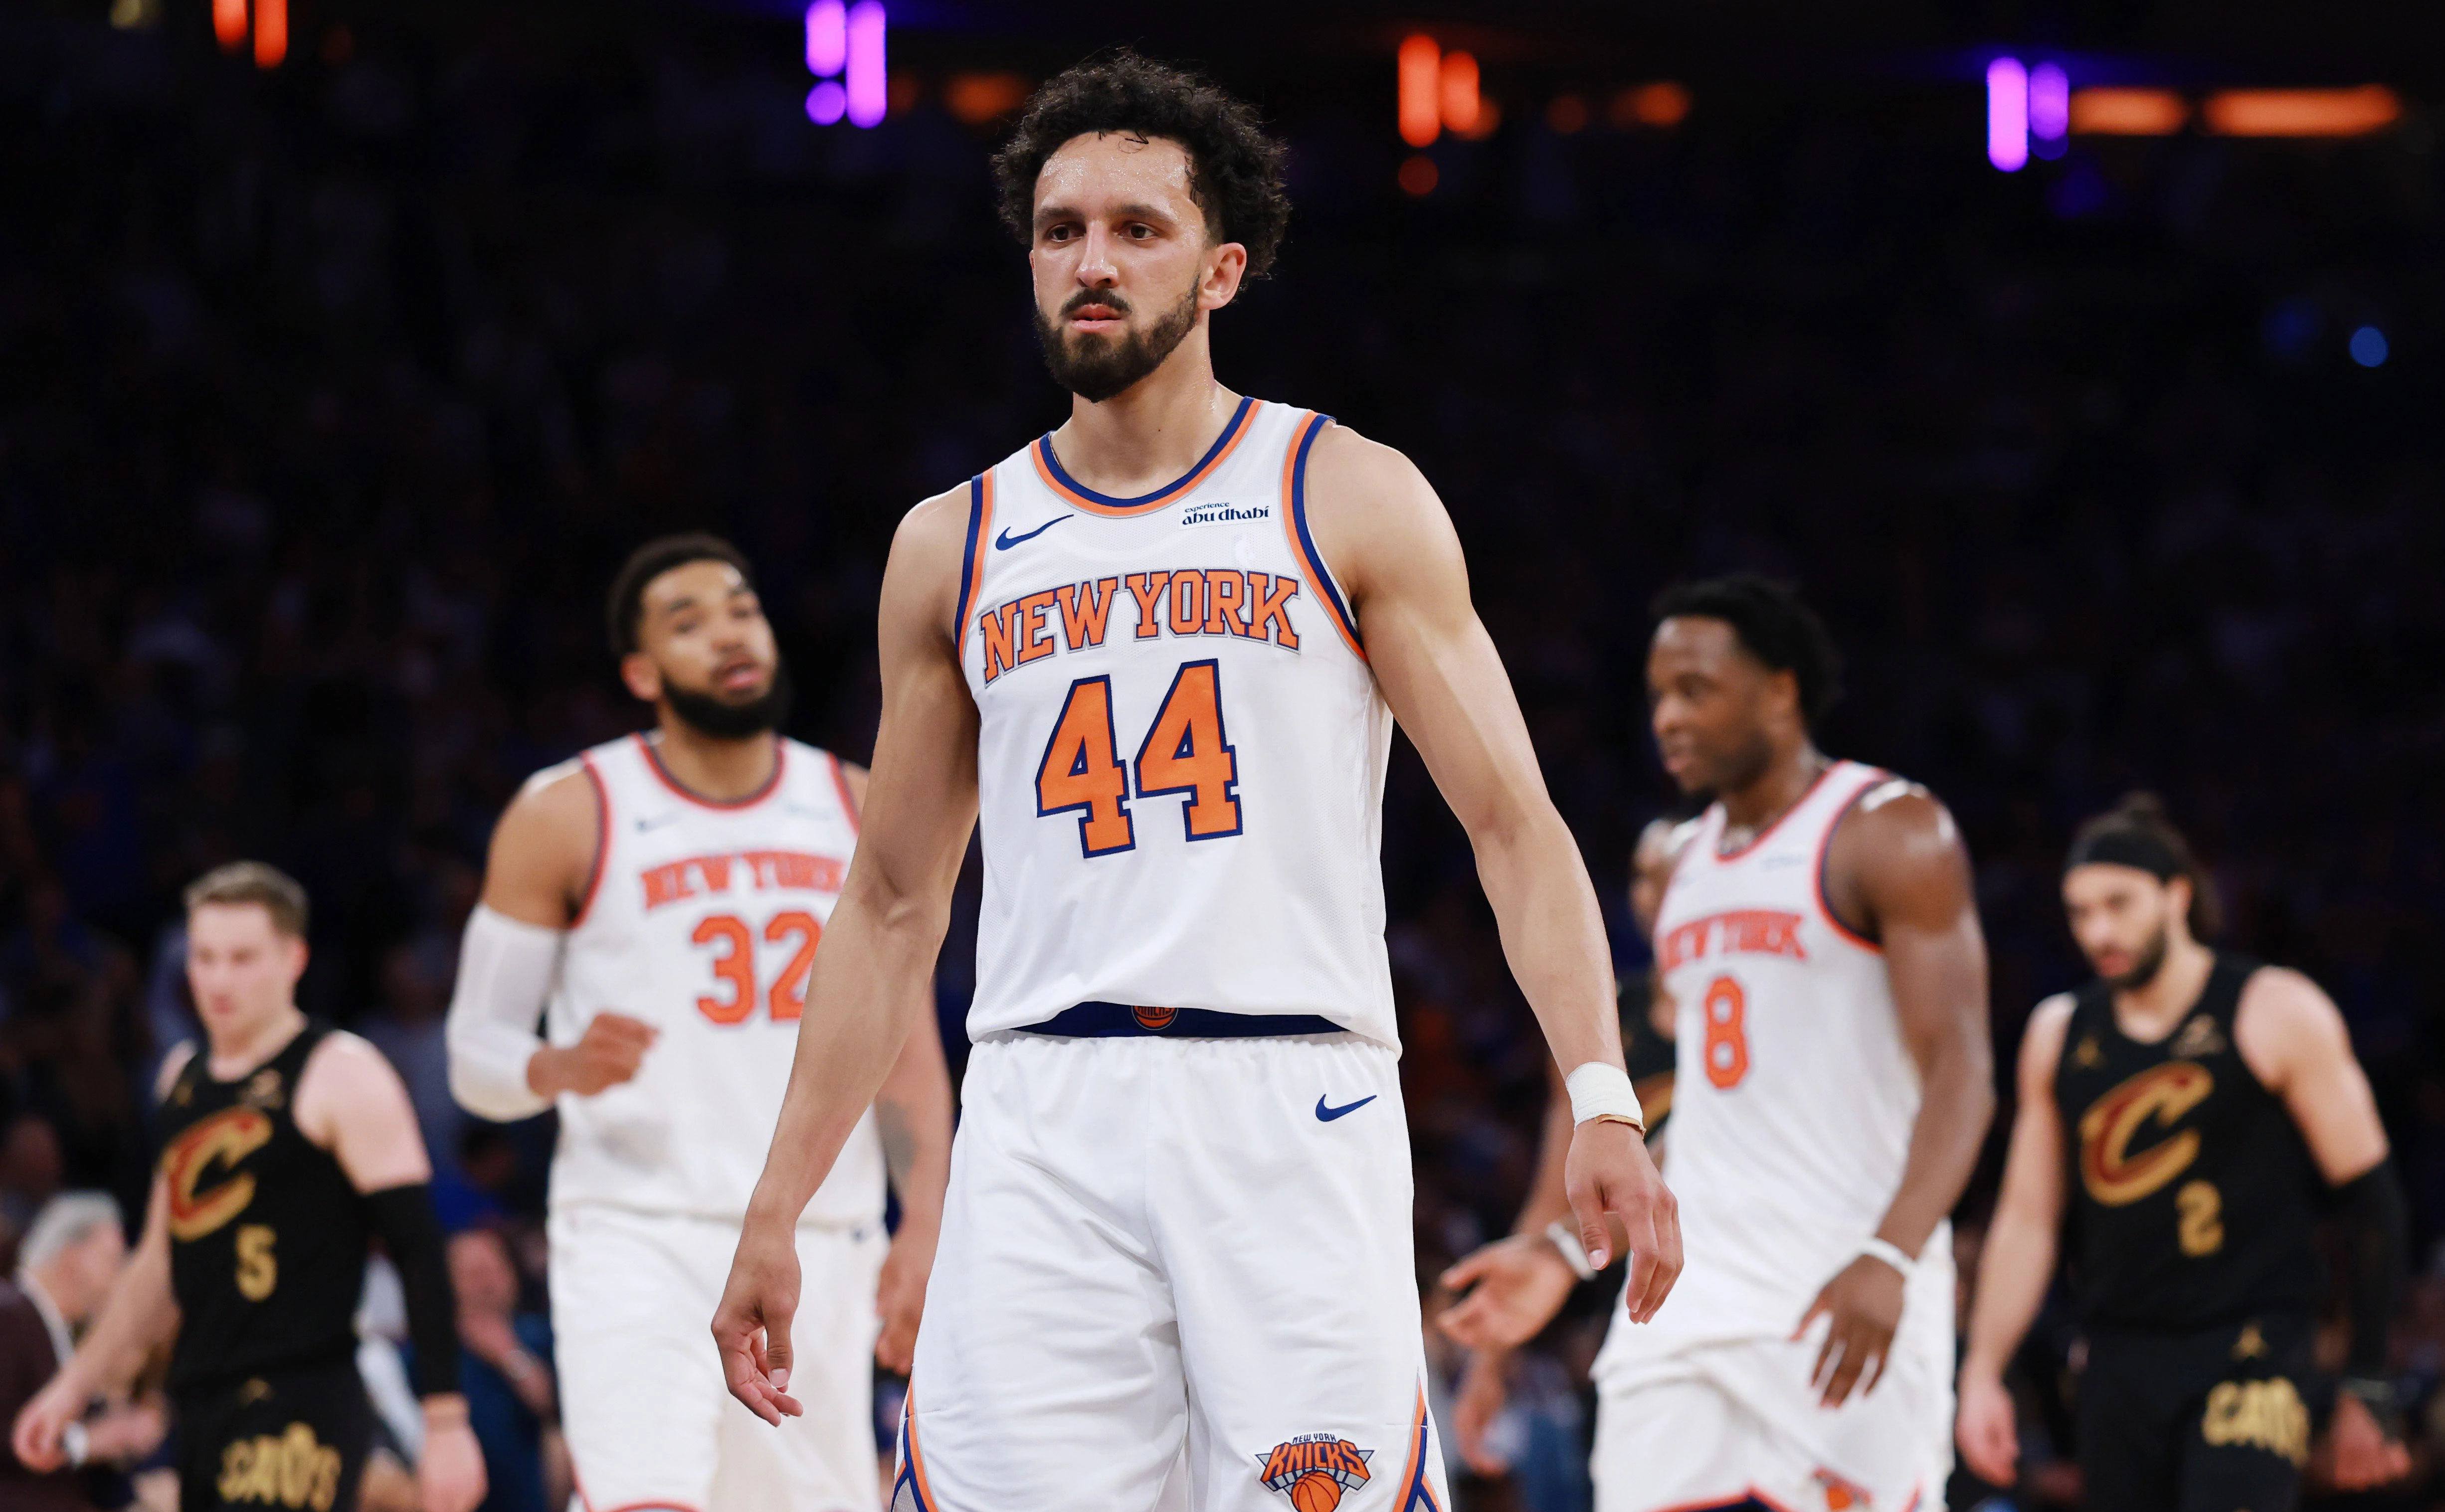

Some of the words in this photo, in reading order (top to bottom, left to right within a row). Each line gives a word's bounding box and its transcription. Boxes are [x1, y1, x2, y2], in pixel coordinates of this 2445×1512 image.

[1182, 511, 1215, 525] abu
[1185, 502, 1230, 512] experience
[979, 573, 1121, 688] NEW
[1124, 567, 1302, 655] YORK
[1035, 658, 1243, 858] 44
[640, 855, 733, 910] NEW
[692, 911, 823, 1024] 32
[1703, 975, 1750, 1090] 8
[159, 1103, 275, 1243] C
[2077, 1059, 2215, 1207] C
[2175, 1178, 2225, 1258] 2
[234, 1223, 279, 1302] 5
[1260, 1439, 1371, 1484] KNICKS
[1292, 1434, 1311, 1444] NEW
[1314, 1433, 1337, 1442] YORK
